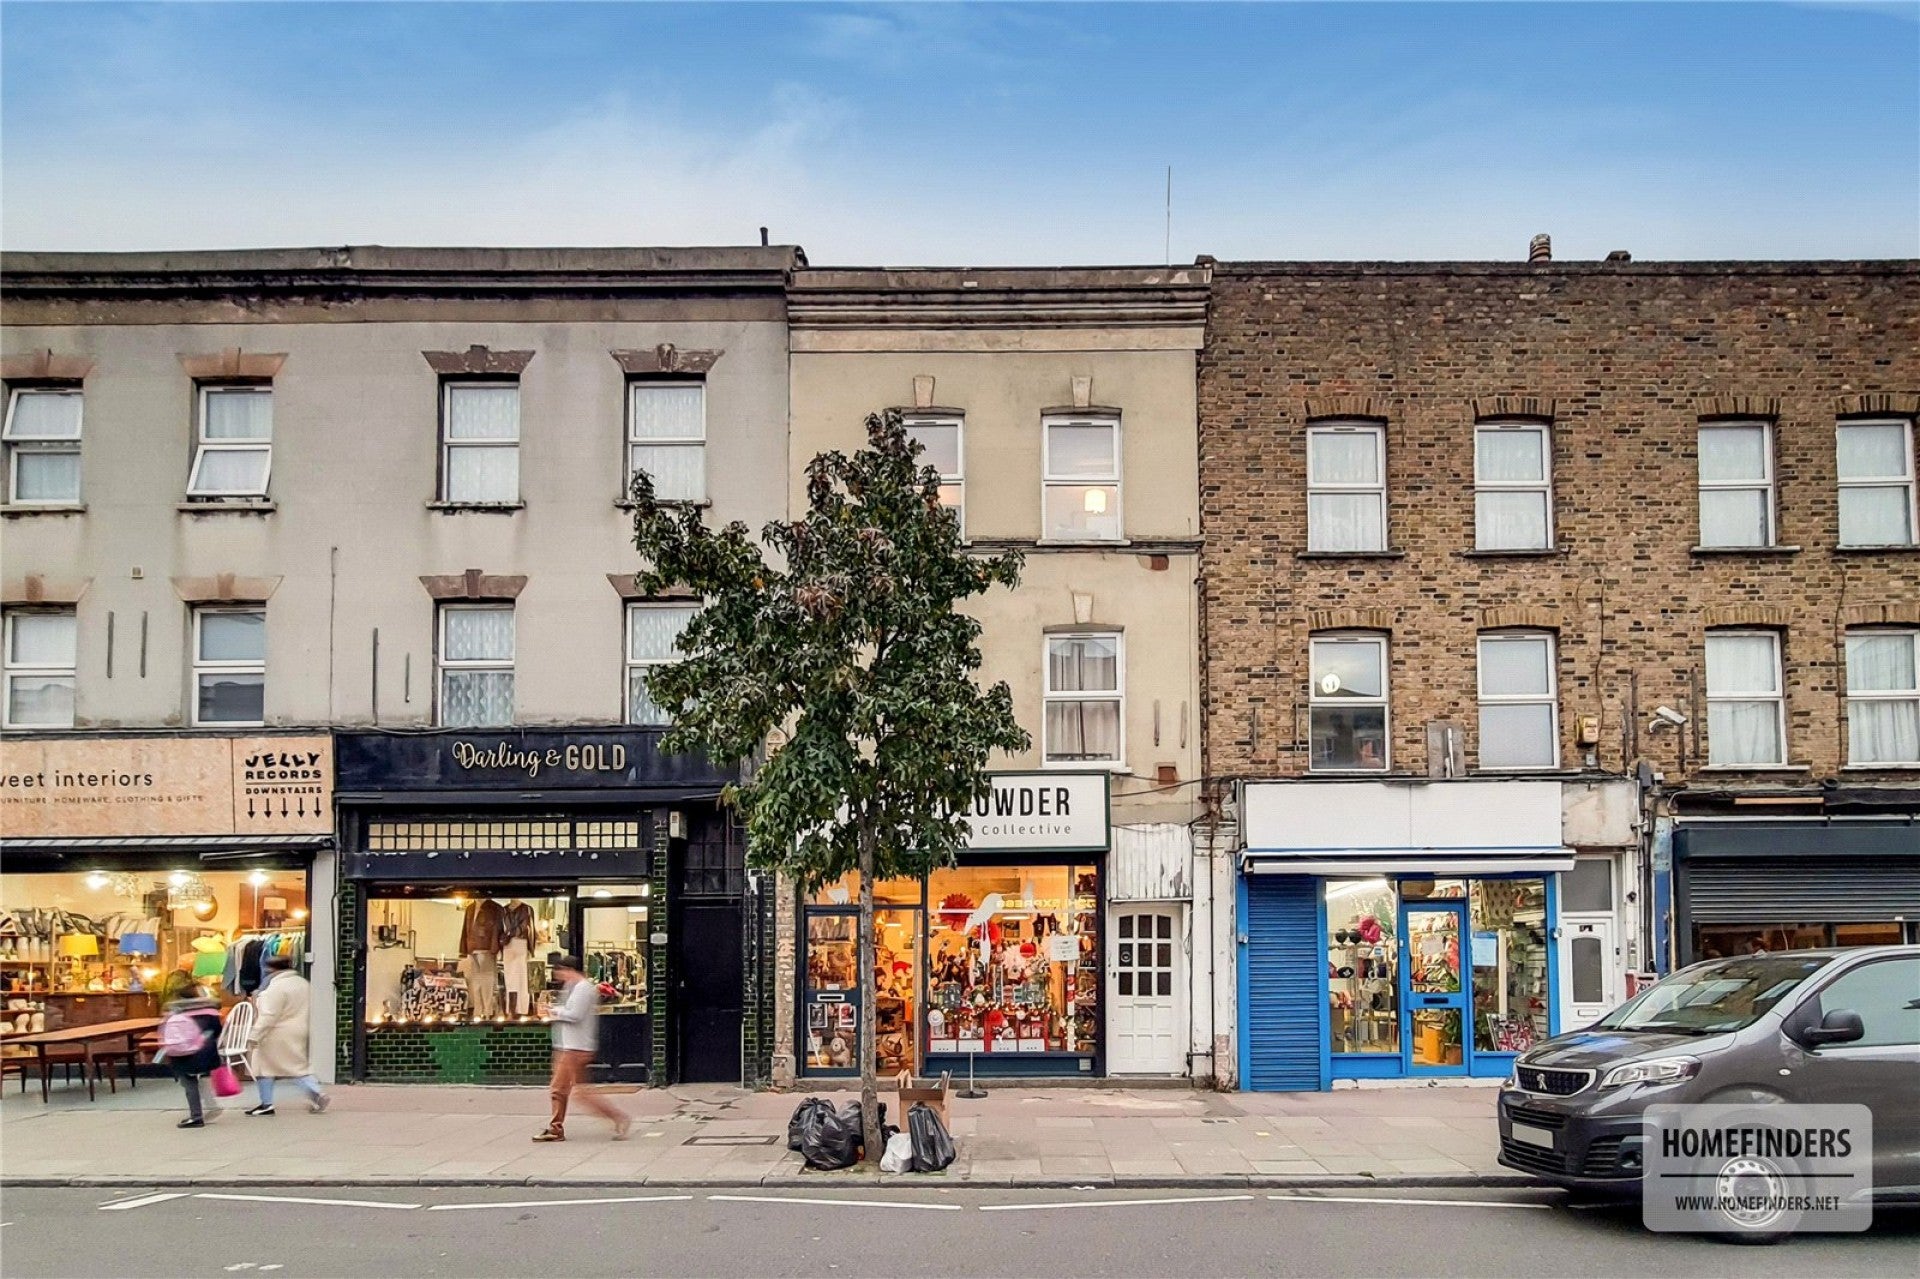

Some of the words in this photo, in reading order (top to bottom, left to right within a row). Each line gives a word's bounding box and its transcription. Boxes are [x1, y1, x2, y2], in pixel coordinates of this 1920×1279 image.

[245, 752, 320, 768] JELLY
[452, 741, 541, 778] Darling
[545, 749, 562, 767] &
[565, 744, 626, 771] GOLD
[55, 770, 153, 787] interiors
[245, 770, 322, 780] RECORDS
[245, 787, 322, 795] DOWNSTAIRS
[982, 824, 1072, 836] Collective
